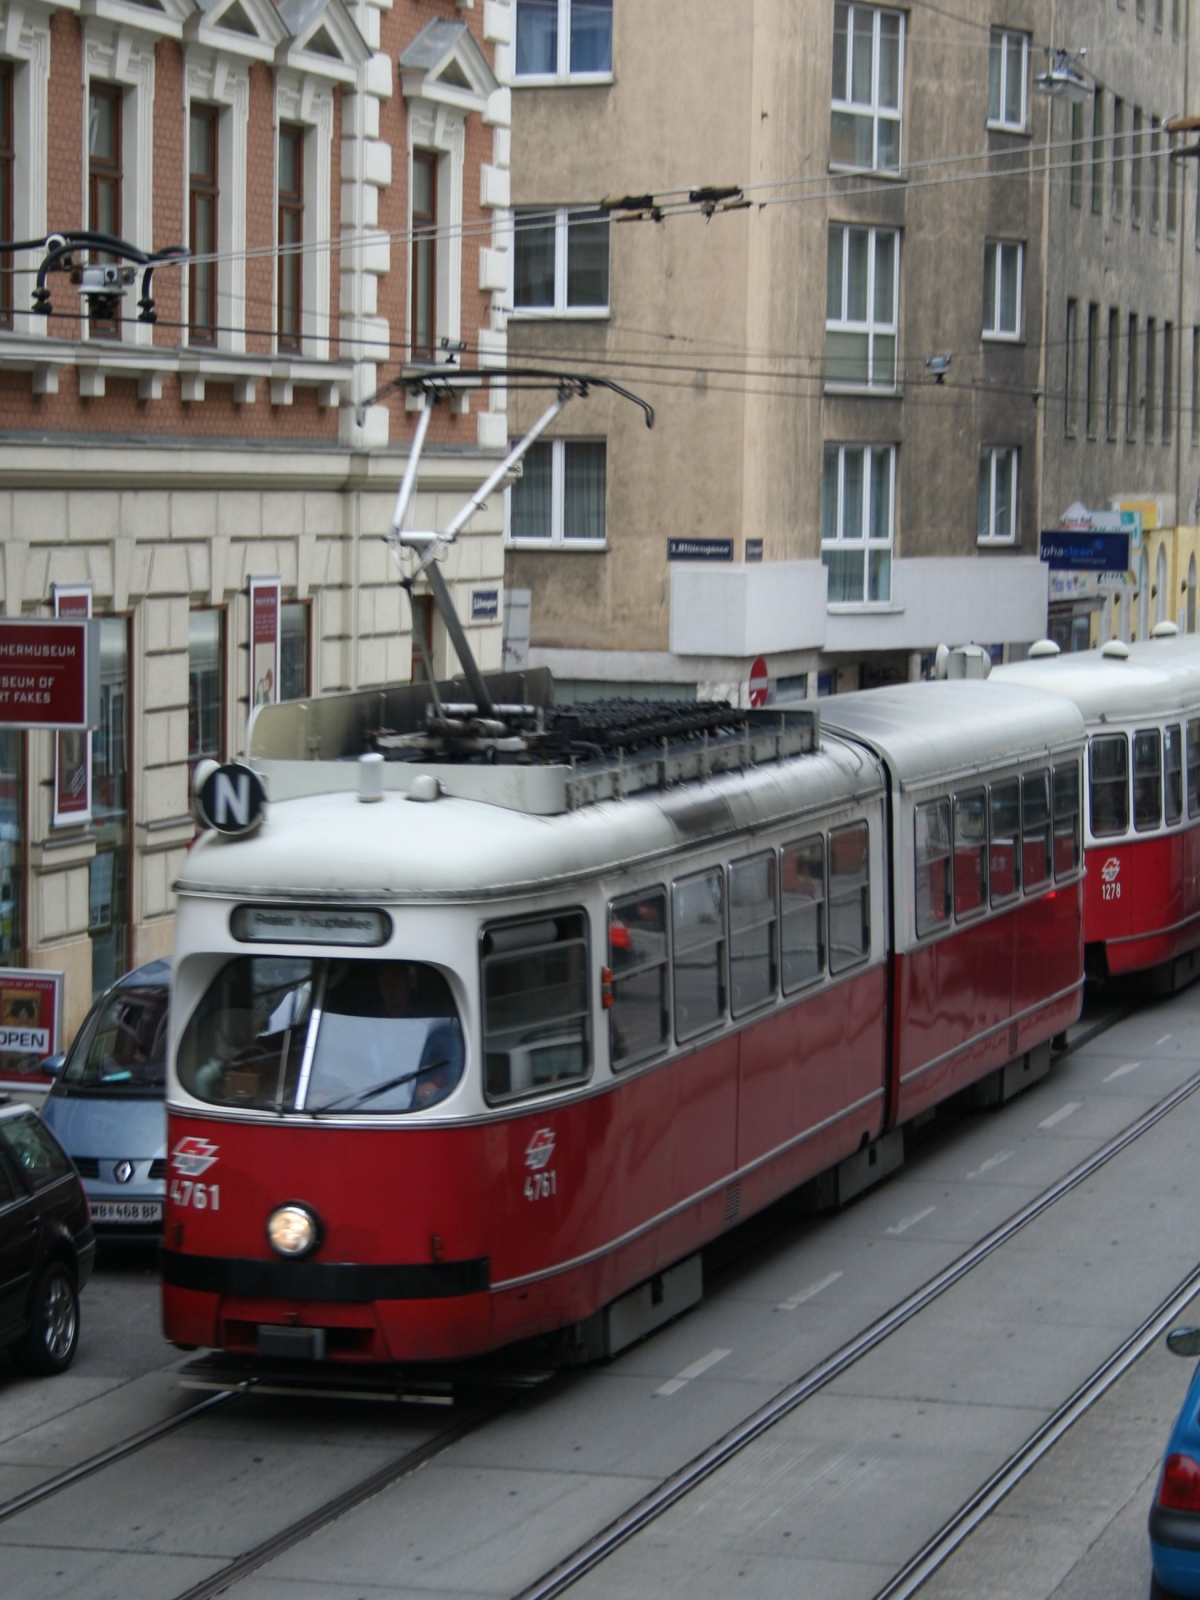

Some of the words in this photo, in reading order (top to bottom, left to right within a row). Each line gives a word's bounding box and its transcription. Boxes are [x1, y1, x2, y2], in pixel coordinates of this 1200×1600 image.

[0, 676, 35, 689] SEUM
[39, 676, 55, 689] OF
[14, 691, 51, 704] FAKES
[214, 772, 250, 826] N
[1101, 882, 1121, 900] 1278
[169, 1180, 220, 1211] 4761
[524, 1169, 557, 1202] 4761
